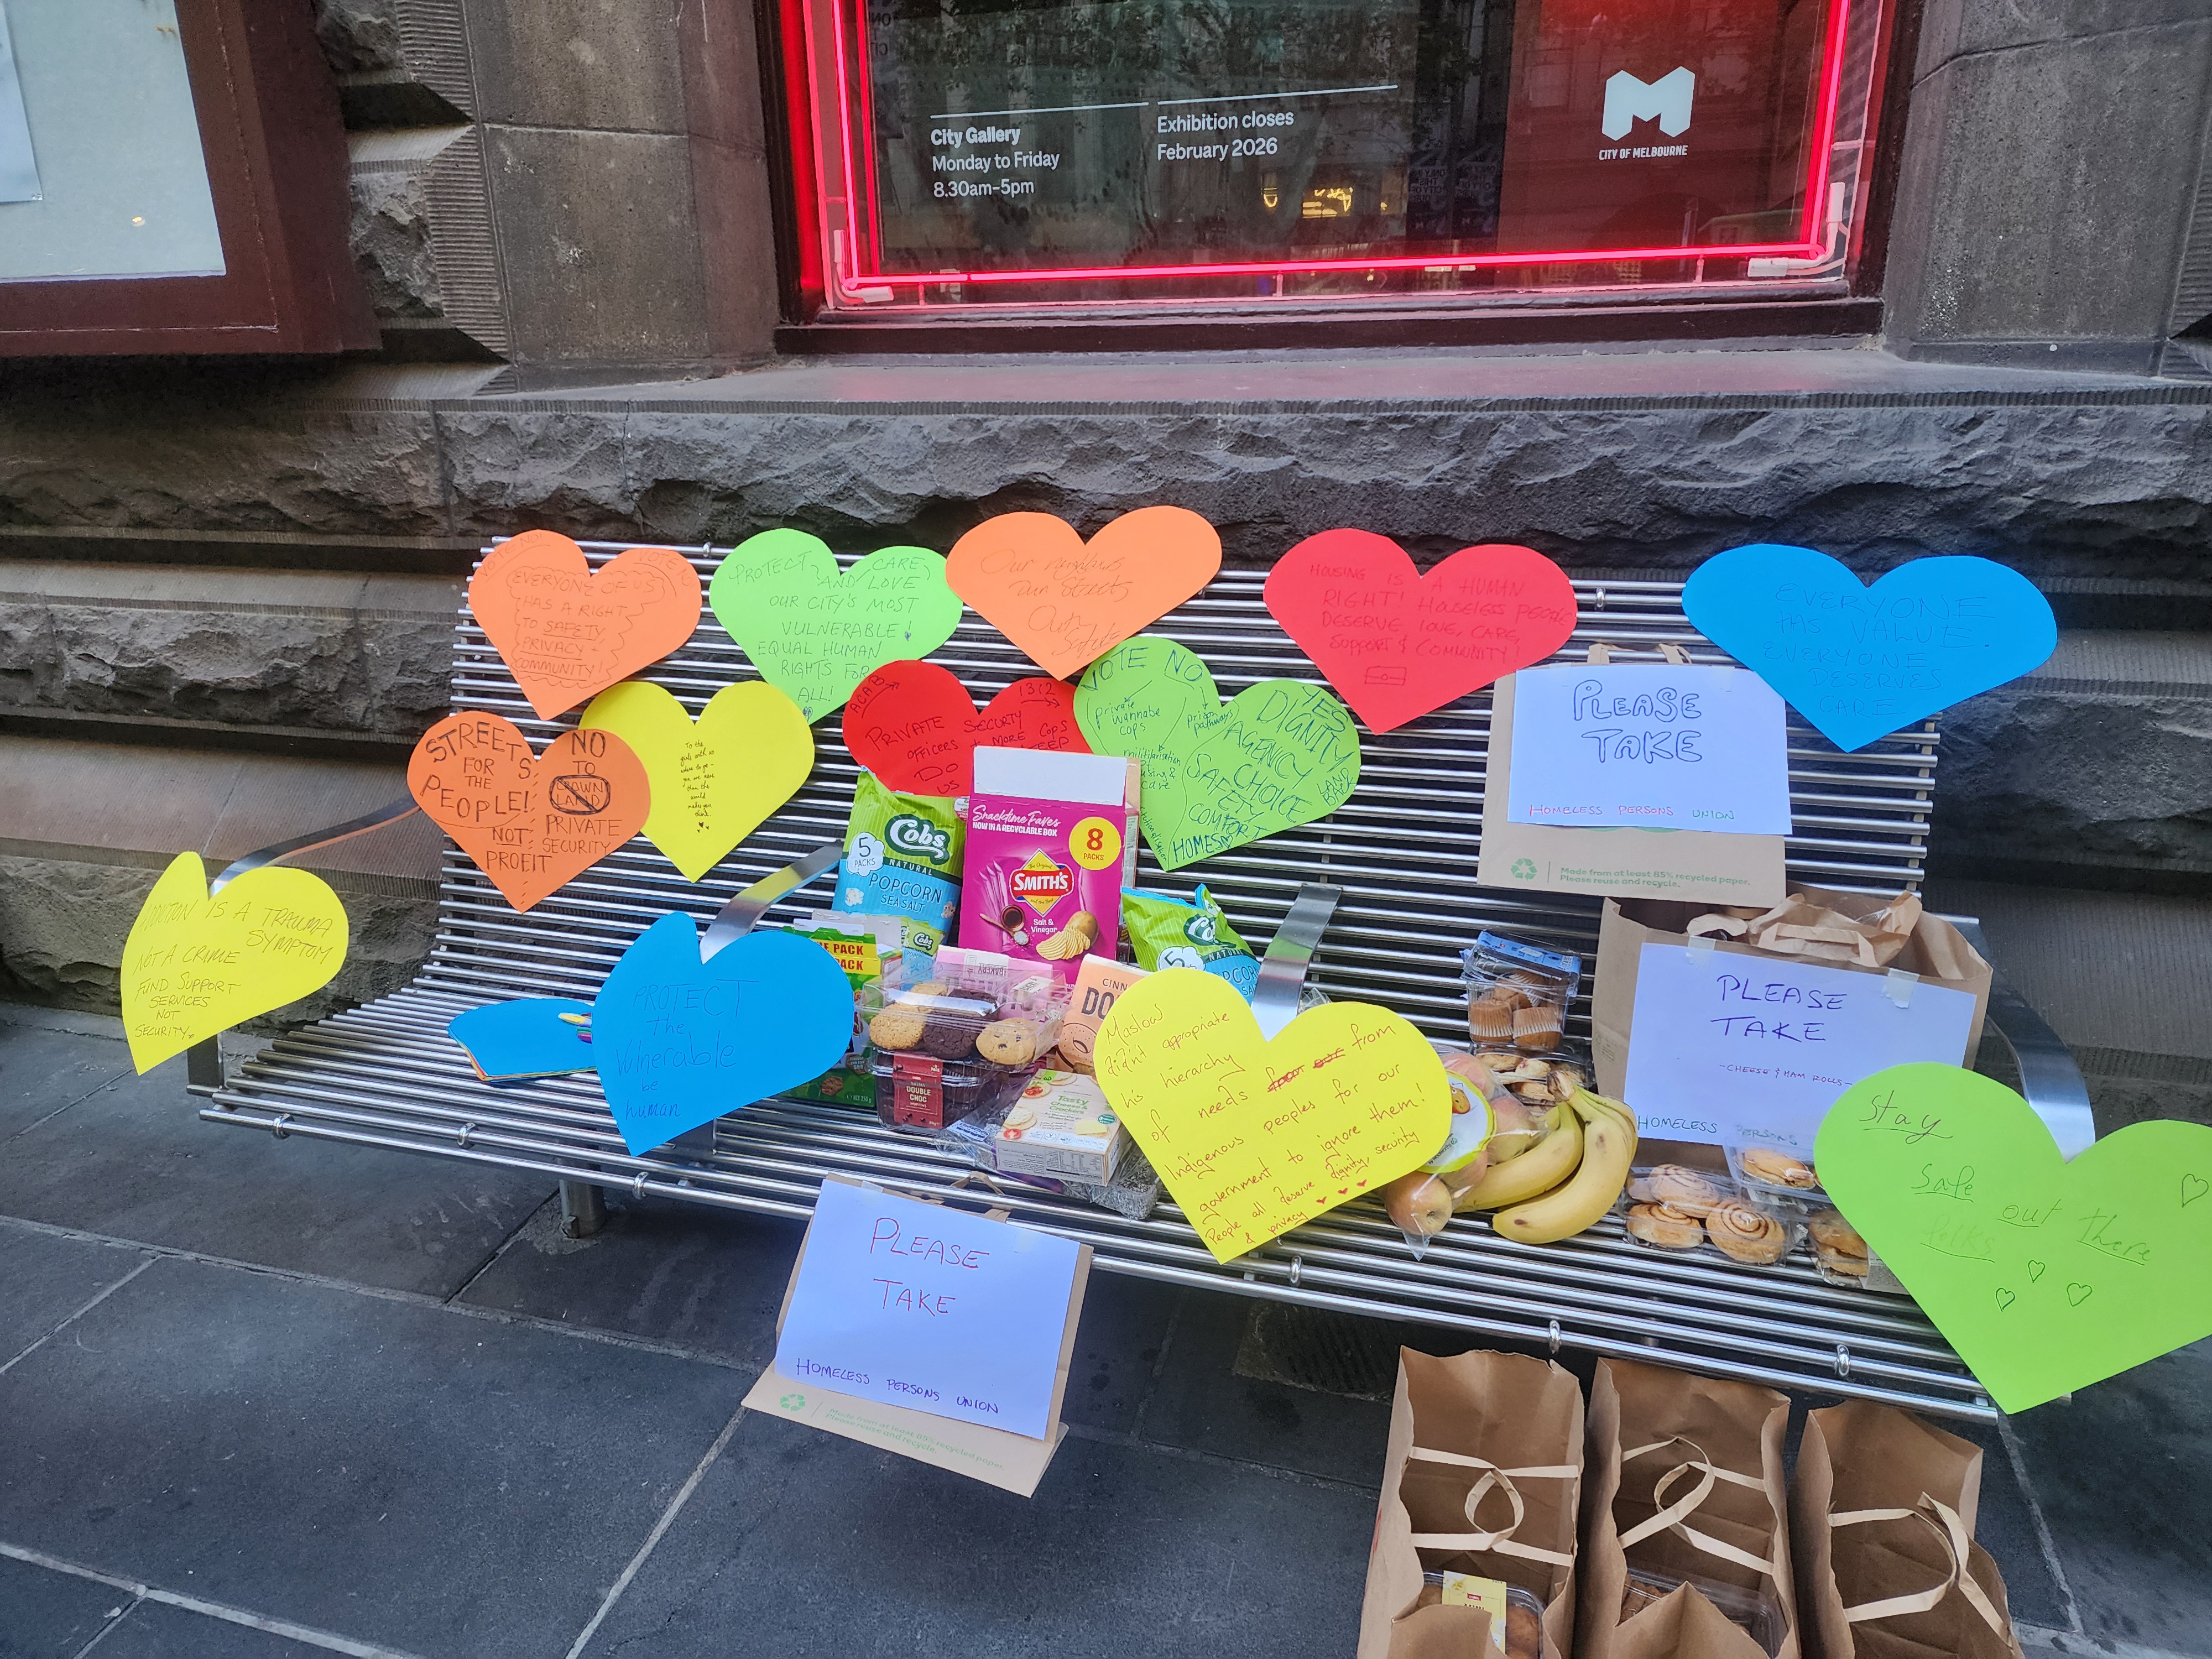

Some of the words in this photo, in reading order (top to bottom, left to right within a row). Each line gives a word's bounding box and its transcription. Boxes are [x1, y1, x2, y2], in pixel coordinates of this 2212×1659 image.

[1158, 113, 1238, 133] Exhibition
[1242, 111, 1293, 128] closes
[931, 129, 963, 148] City
[966, 127, 1020, 145] Gallery
[1158, 143, 1229, 161] February
[1232, 137, 1278, 156] 2026
[932, 154, 991, 173] Monday
[995, 153, 1010, 168] to
[1014, 150, 1060, 169] Friday
[1599, 149, 1618, 160] CITY
[1619, 148, 1631, 159] OF
[1632, 145, 1688, 158] MELBOURNE
[728, 551, 812, 585] PROTECT
[872, 557, 926, 571] CARE
[601, 581, 627, 594] OF
[633, 578, 656, 593] US
[817, 575, 855, 589] AND
[868, 576, 921, 590] LOVE
[1388, 573, 1404, 585] IS
[1431, 577, 1442, 592] A
[1459, 578, 1526, 598] HUMAN
[523, 594, 553, 610] HAS
[561, 602, 572, 615] A
[577, 605, 628, 617] RIGHT
[770, 595, 799, 608] OUR
[867, 597, 919, 613] MOST
[1775, 582, 1995, 620] EVERYONE
[522, 617, 538, 629] TO
[1322, 611, 1404, 632] DESERVE
[1776, 611, 1822, 635] HAS
[523, 637, 585, 656] PRIVACY
[758, 640, 813, 657] EQUAL
[823, 640, 882, 659] HUMAN
[1764, 641, 1928, 670] EVERYONE
[781, 659, 832, 681] RIGHTS
[1080, 646, 1150, 691] VOTE
[1811, 668, 1943, 691] DESERVES
[850, 675, 885, 713] ACAB
[1019, 682, 1056, 697] 1312
[1095, 701, 1135, 730] private
[1112, 706, 1162, 725] wannabe
[1301, 685, 1349, 734] YES
[865, 716, 945, 752] PRIVATE
[992, 732, 1026, 747] MORE
[1120, 722, 1146, 740] cops
[1256, 689, 1357, 773] DIGNITY
[425, 721, 533, 780] STREETS
[572, 730, 606, 758] NO
[1223, 721, 1313, 790] AGENCY
[1581, 728, 1702, 764] TAKE
[463, 757, 495, 776] FOR
[572, 760, 596, 775] TO
[465, 775, 493, 790] THE
[936, 781, 960, 795] US
[1187, 753, 1265, 823] SAFETY
[1233, 763, 1313, 823] CHOICE
[419, 774, 529, 822] PEOPLE!
[972, 804, 1029, 825] Snacktime
[1530, 805, 1603, 817] HOMELESS
[1618, 805, 1674, 816] PERSONS
[1692, 810, 1735, 821] UNION
[492, 827, 529, 845] NOT
[546, 813, 623, 837] PRIVATE
[972, 822, 988, 830] NOW
[1001, 825, 1043, 836] RECYCLABLE
[1043, 828, 1057, 837] BOX
[542, 838, 611, 856] SECURITY
[859, 837, 871, 857] 5
[890, 818, 946, 859] Cobs
[1087, 828, 1103, 851] 8
[1173, 832, 1223, 863] HOMES
[486, 851, 554, 873] PROFIT
[854, 858, 876, 868] PACKS
[889, 858, 933, 877] NATURAL
[1083, 853, 1104, 861] PACKS
[869, 873, 943, 904] POPCORN
[1014, 872, 1069, 891] SMITH'S
[1560, 875, 1592, 883] Please
[1642, 880, 1681, 889] recycle.
[1653, 870, 1673, 879] 85%
[1676, 874, 1717, 883] recycled
[1719, 877, 1751, 885] paper.
[881, 895, 903, 907] SEA
[902, 900, 925, 912] SALT
[205, 901, 228, 919] IS
[233, 901, 251, 921] A
[264, 907, 332, 938] TRAUMA
[1030, 926, 1058, 934] Vinegar
[246, 929, 333, 964] SYMPTOM
[833, 943, 864, 956] PACK
[132, 946, 164, 975] NOT
[181, 945, 241, 964] CRIME
[134, 977, 169, 1002] FUND
[176, 971, 241, 994] SUPPORT
[633, 978, 760, 1018] PROTECT
[1717, 975, 1848, 1010] PLEASE
[149, 995, 211, 1008] SERVICES
[156, 1009, 181, 1021] NOT
[1105, 1003, 1165, 1045] Maslow
[1710, 1016, 1826, 1042] TAKE
[1104, 1044, 1147, 1077] didn't
[1162, 1011, 1230, 1050] appropriate
[641, 1078, 659, 1092] be
[1121, 1088, 1144, 1109] his
[1160, 1054, 1246, 1088] hierarchy
[1151, 1109, 1170, 1143] of
[1197, 1086, 1249, 1119] needs
[1351, 1023, 1396, 1052] from
[1783, 1070, 1806, 1079] HAM
[906, 1086, 931, 1096] DOUBLE
[910, 1094, 927, 1103] CHOC
[1058, 1095, 1089, 1105] Tasty
[625, 1102, 681, 1121] human
[1165, 1135, 1245, 1181] Indigenous
[1263, 1099, 1316, 1134] peoples
[1334, 1079, 1360, 1106] for
[1378, 1063, 1402, 1082] our
[1859, 1090, 1943, 1144] Stay
[1637, 1115, 1718, 1134] HOMELESS
[1199, 1156, 1273, 1225] government
[1288, 1150, 1304, 1164] to
[1318, 1125, 1361, 1160] ignore
[1369, 1082, 1425, 1124] them!
[1205, 1220, 1242, 1245] People
[1251, 1201, 1265, 1218] all
[1272, 1181, 1316, 1206] deserve
[1375, 1129, 1420, 1155] security
[1912, 1162, 1974, 1198] Safe
[1268, 1211, 1309, 1234] privacy
[2002, 1199, 2063, 1225] out
[870, 1217, 990, 1269] PLEASE
[873, 1278, 957, 1317] TAKE
[796, 1358, 870, 1386] HOMELESS
[886, 1378, 941, 1402] PERSONS
[956, 1395, 999, 1415] UNION
